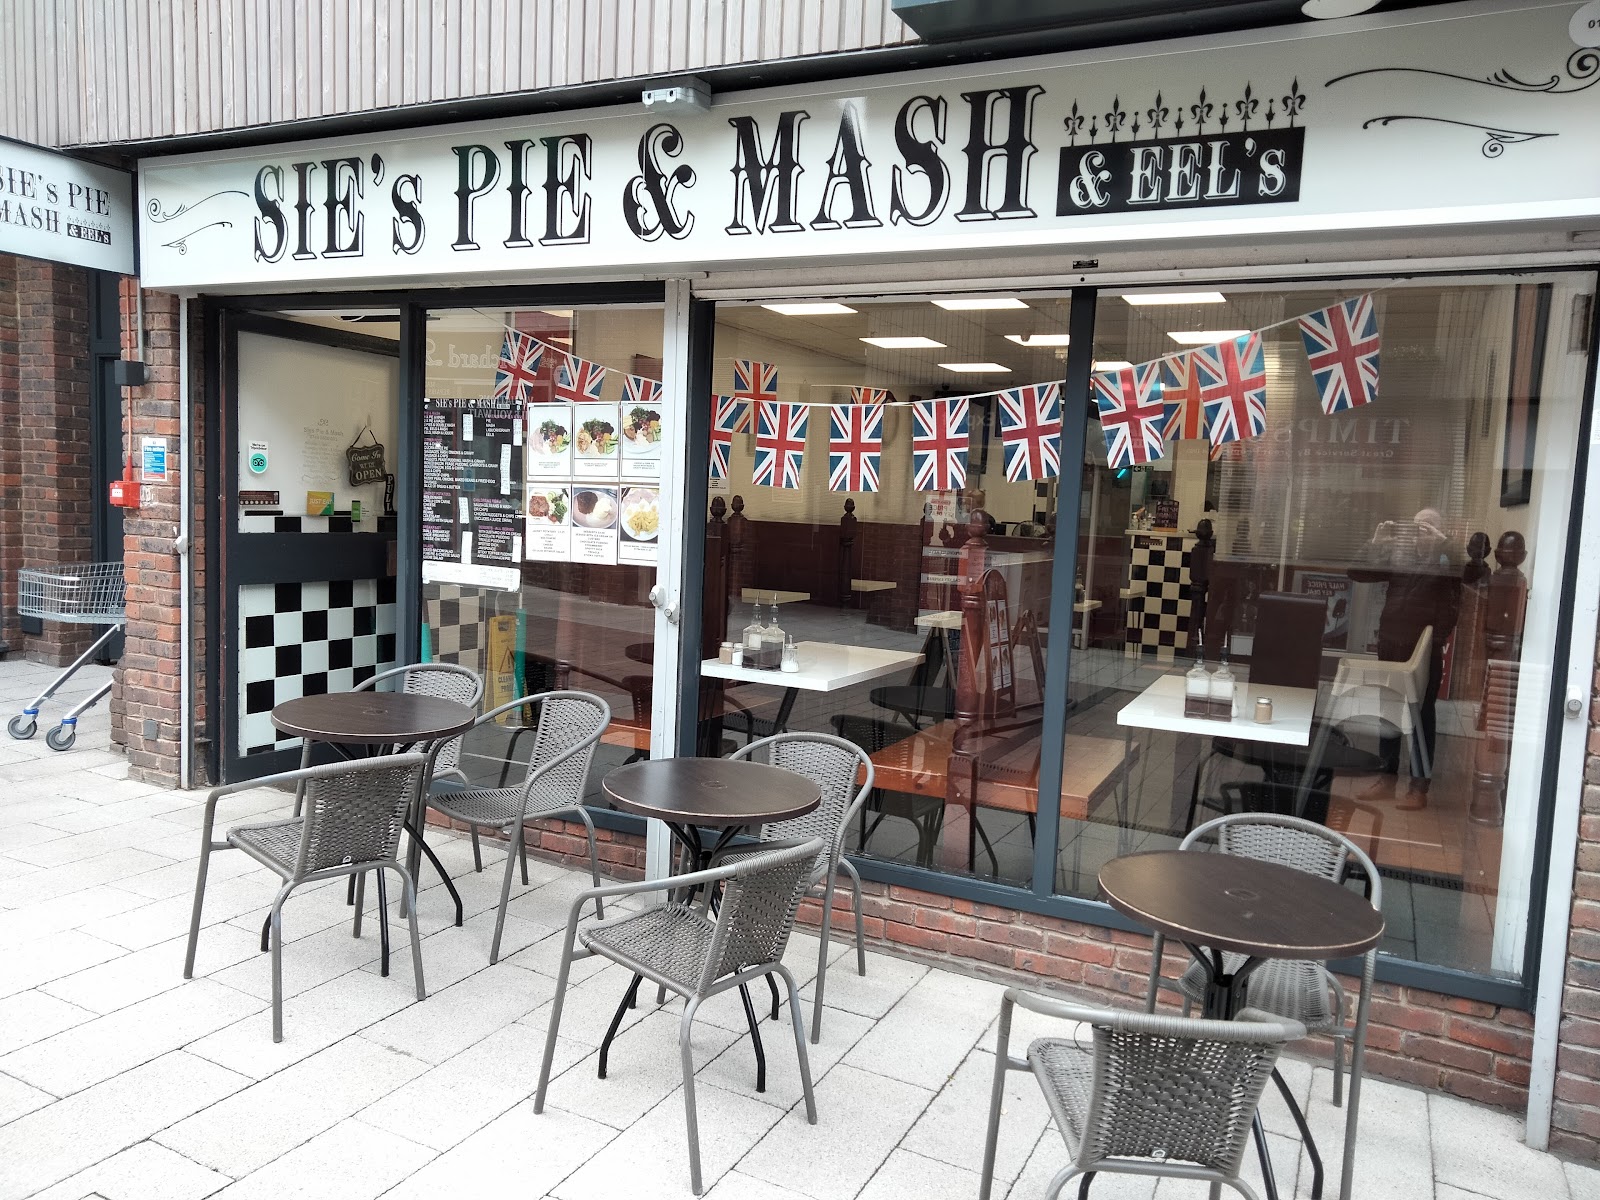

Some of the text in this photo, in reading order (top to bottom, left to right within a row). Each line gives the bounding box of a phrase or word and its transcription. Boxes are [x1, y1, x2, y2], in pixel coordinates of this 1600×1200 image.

[450, 133, 593, 252] PIE
[622, 122, 697, 242] &
[724, 84, 1047, 236] MASH
[1069, 149, 1111, 209] &
[67, 182, 111, 218] PIE
[68, 223, 79, 238] &
[453, 398, 467, 408] PIE
[351, 450, 381, 462] Come In
[355, 468, 382, 480] OPEN
[385, 475, 394, 512] PULL
